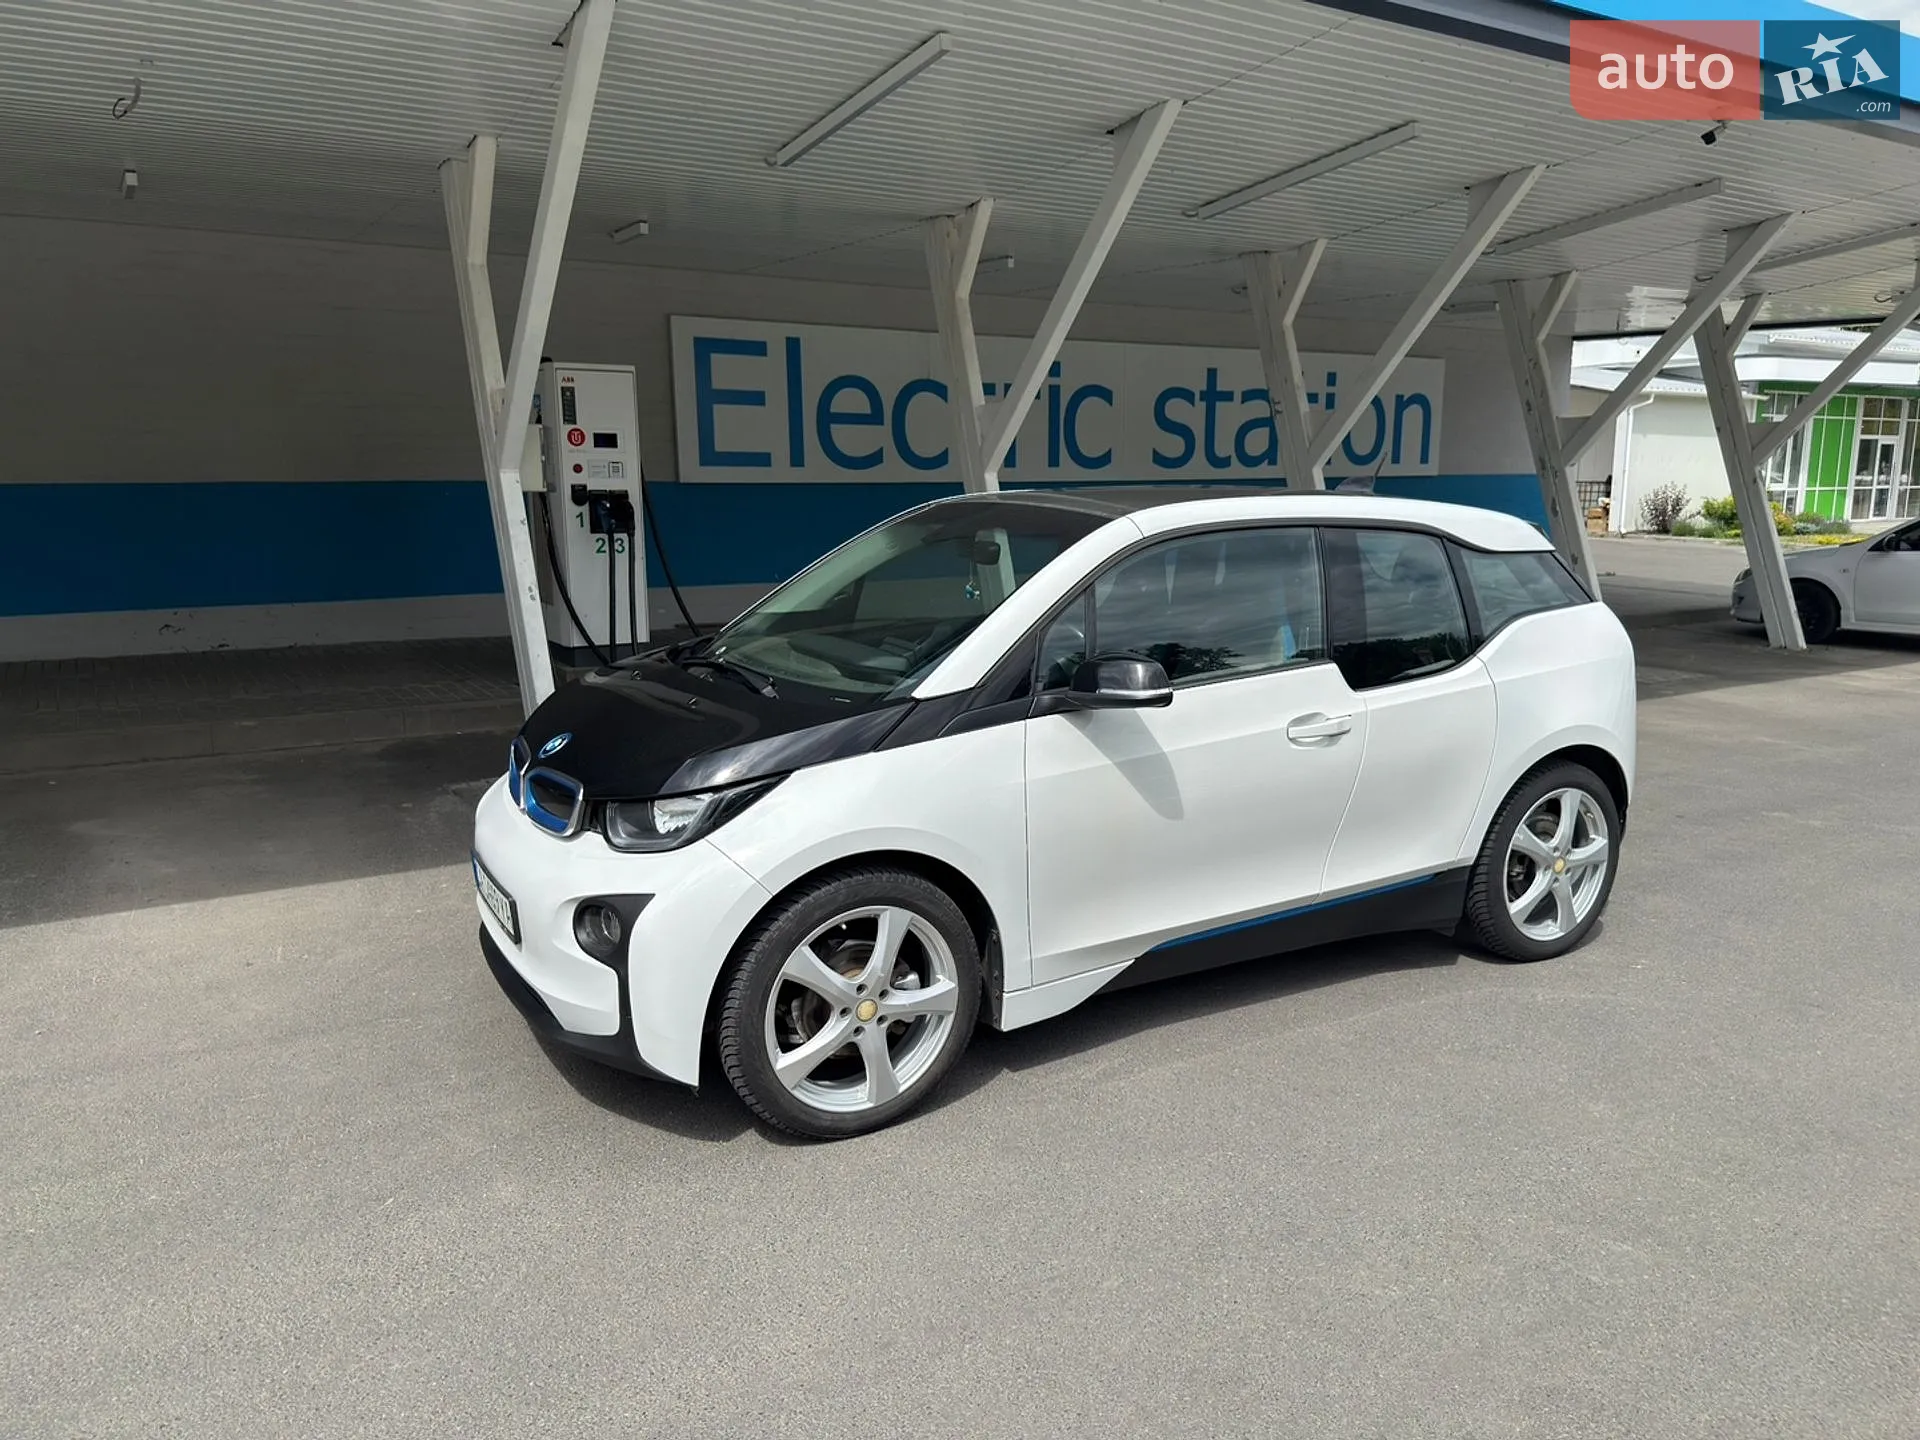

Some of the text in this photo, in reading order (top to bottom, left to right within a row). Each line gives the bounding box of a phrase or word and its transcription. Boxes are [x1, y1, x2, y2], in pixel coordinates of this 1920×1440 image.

[692, 336, 1113, 471] Elecic
[576, 511, 585, 528] 1
[595, 537, 626, 554] 2 3
